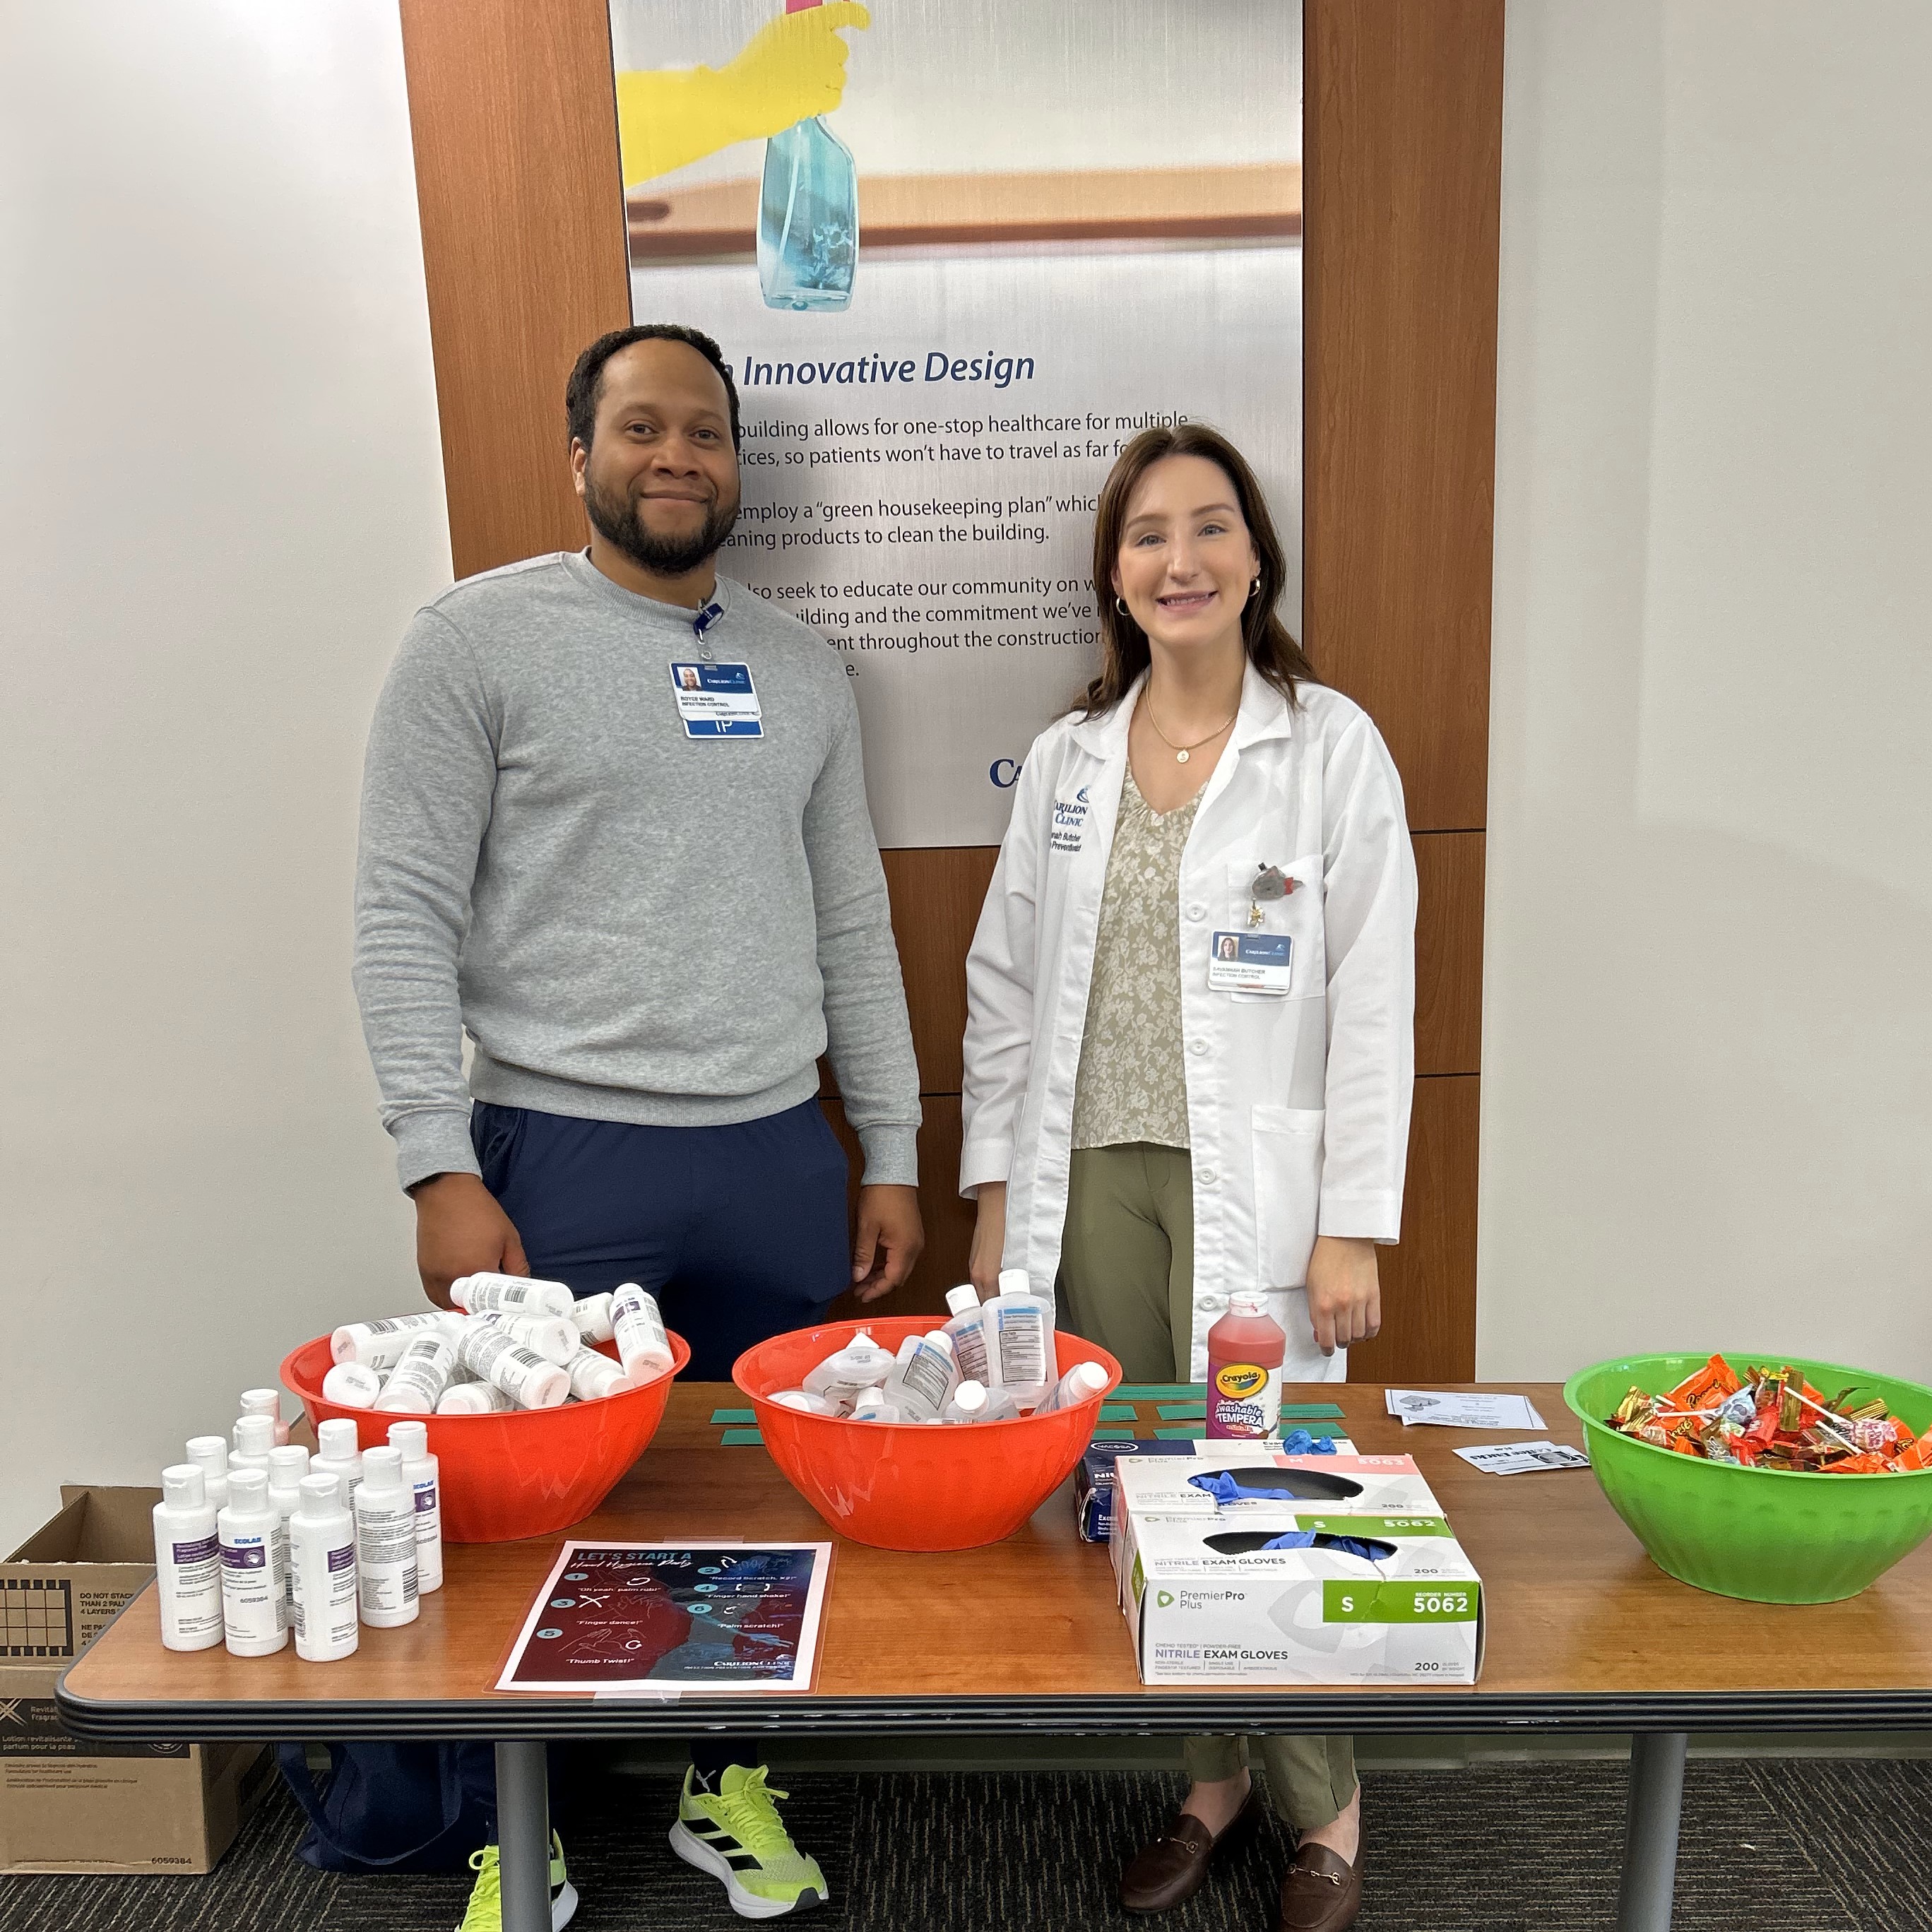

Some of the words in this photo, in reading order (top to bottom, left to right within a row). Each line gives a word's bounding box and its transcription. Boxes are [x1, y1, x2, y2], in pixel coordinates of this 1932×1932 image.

[744, 353, 915, 386] Innovative
[925, 350, 1035, 389] Design
[814, 418, 870, 436] allows
[874, 417, 899, 435] for
[903, 417, 983, 437] one-stop
[989, 414, 1081, 432] healthcare
[1086, 413, 1110, 430] for
[1115, 411, 1188, 429] multiple
[785, 451, 804, 464] so
[810, 446, 880, 468] patients
[940, 444, 981, 460] have
[985, 444, 1004, 459] to
[1009, 441, 1057, 458] travel
[1063, 444, 1081, 457] as
[1086, 440, 1108, 456] far
[804, 505, 812, 518] a
[879, 498, 1002, 518] housekeeping
[1056, 494, 1101, 512] whic
[719, 531, 776, 550] aning
[782, 528, 860, 550] products
[865, 529, 882, 543] to
[888, 526, 933, 543] clean
[939, 525, 967, 542] the
[973, 523, 1050, 543] building.
[777, 581, 817, 599] seek
[820, 583, 838, 598] to
[843, 581, 913, 597] educate
[918, 582, 947, 596] our
[952, 577, 1052, 596] community
[1057, 579, 1079, 592] on
[855, 607, 887, 624] and
[892, 606, 921, 622] the
[926, 604, 1038, 622] commitment
[859, 632, 960, 653] throughout
[964, 631, 992, 647] the
[1221, 1371, 1258, 1382] Crayola
[1216, 1413, 1264, 1426] TEMPERA
[1218, 1402, 1263, 1417] washable
[1180, 1590, 1245, 1601] PremierPro
[1341, 1596, 1354, 1612] S
[1180, 1600, 1202, 1609] Plus
[1414, 1597, 1468, 1613] 5062
[1155, 1649, 1200, 1659] NITRILE
[1204, 1650, 1238, 1659] EXAM
[1240, 1650, 1288, 1659] GLOVES
[1414, 1662, 1439, 1671] 200
